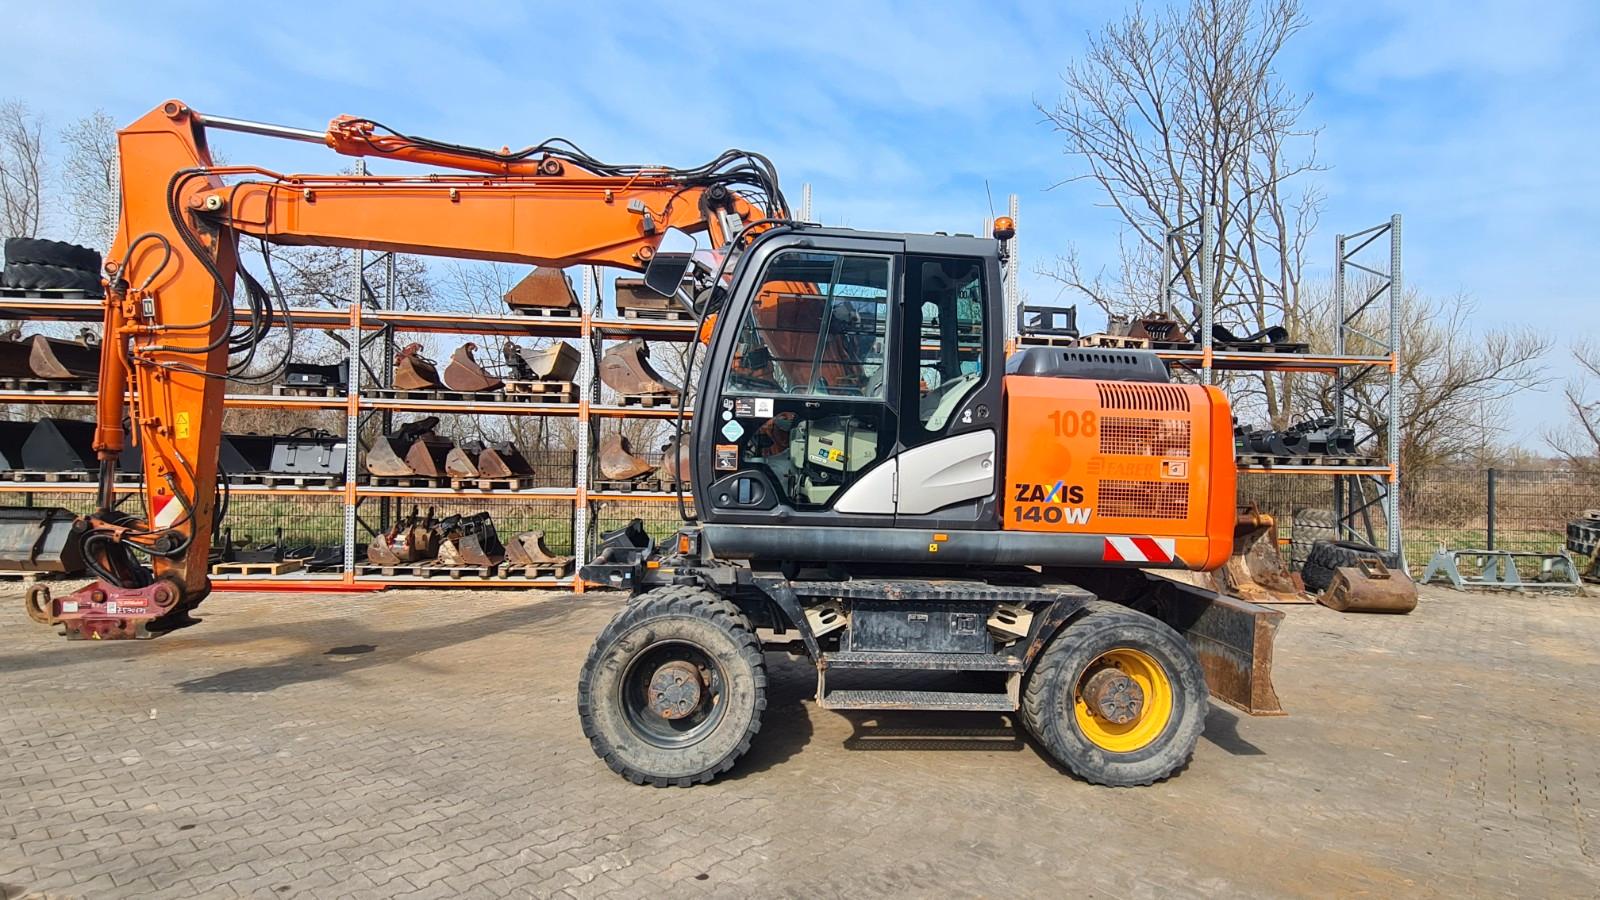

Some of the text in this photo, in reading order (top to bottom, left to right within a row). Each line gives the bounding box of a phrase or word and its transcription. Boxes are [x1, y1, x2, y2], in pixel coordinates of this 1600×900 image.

[1048, 410, 1097, 438] 108
[1015, 480, 1084, 504] ZAXIS
[1014, 506, 1093, 525] 140W
